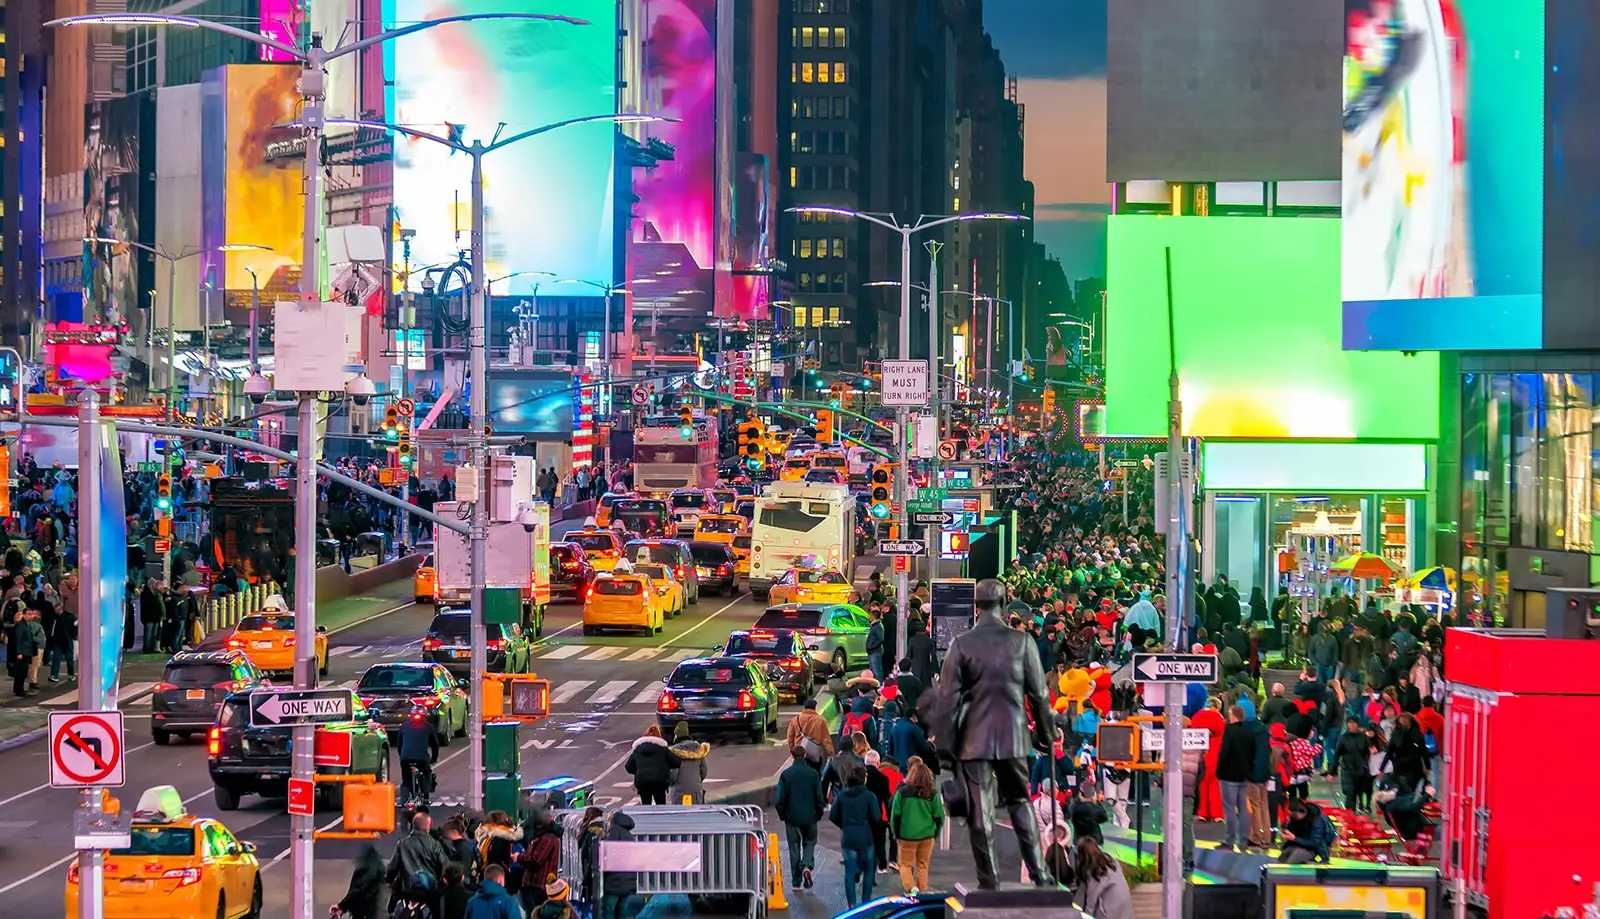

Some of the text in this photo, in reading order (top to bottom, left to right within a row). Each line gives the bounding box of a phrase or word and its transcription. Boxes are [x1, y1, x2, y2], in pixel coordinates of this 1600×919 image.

[884, 366, 926, 374] RIGHT LANE
[892, 379, 917, 388] MUST
[884, 392, 926, 400] TURN RIGHT
[947, 479, 954, 487] W
[957, 479, 965, 487] 45
[919, 489, 927, 499] W
[929, 489, 939, 500] 45
[1158, 663, 1207, 674] ONE WAY
[281, 700, 341, 715] ONE WAY
